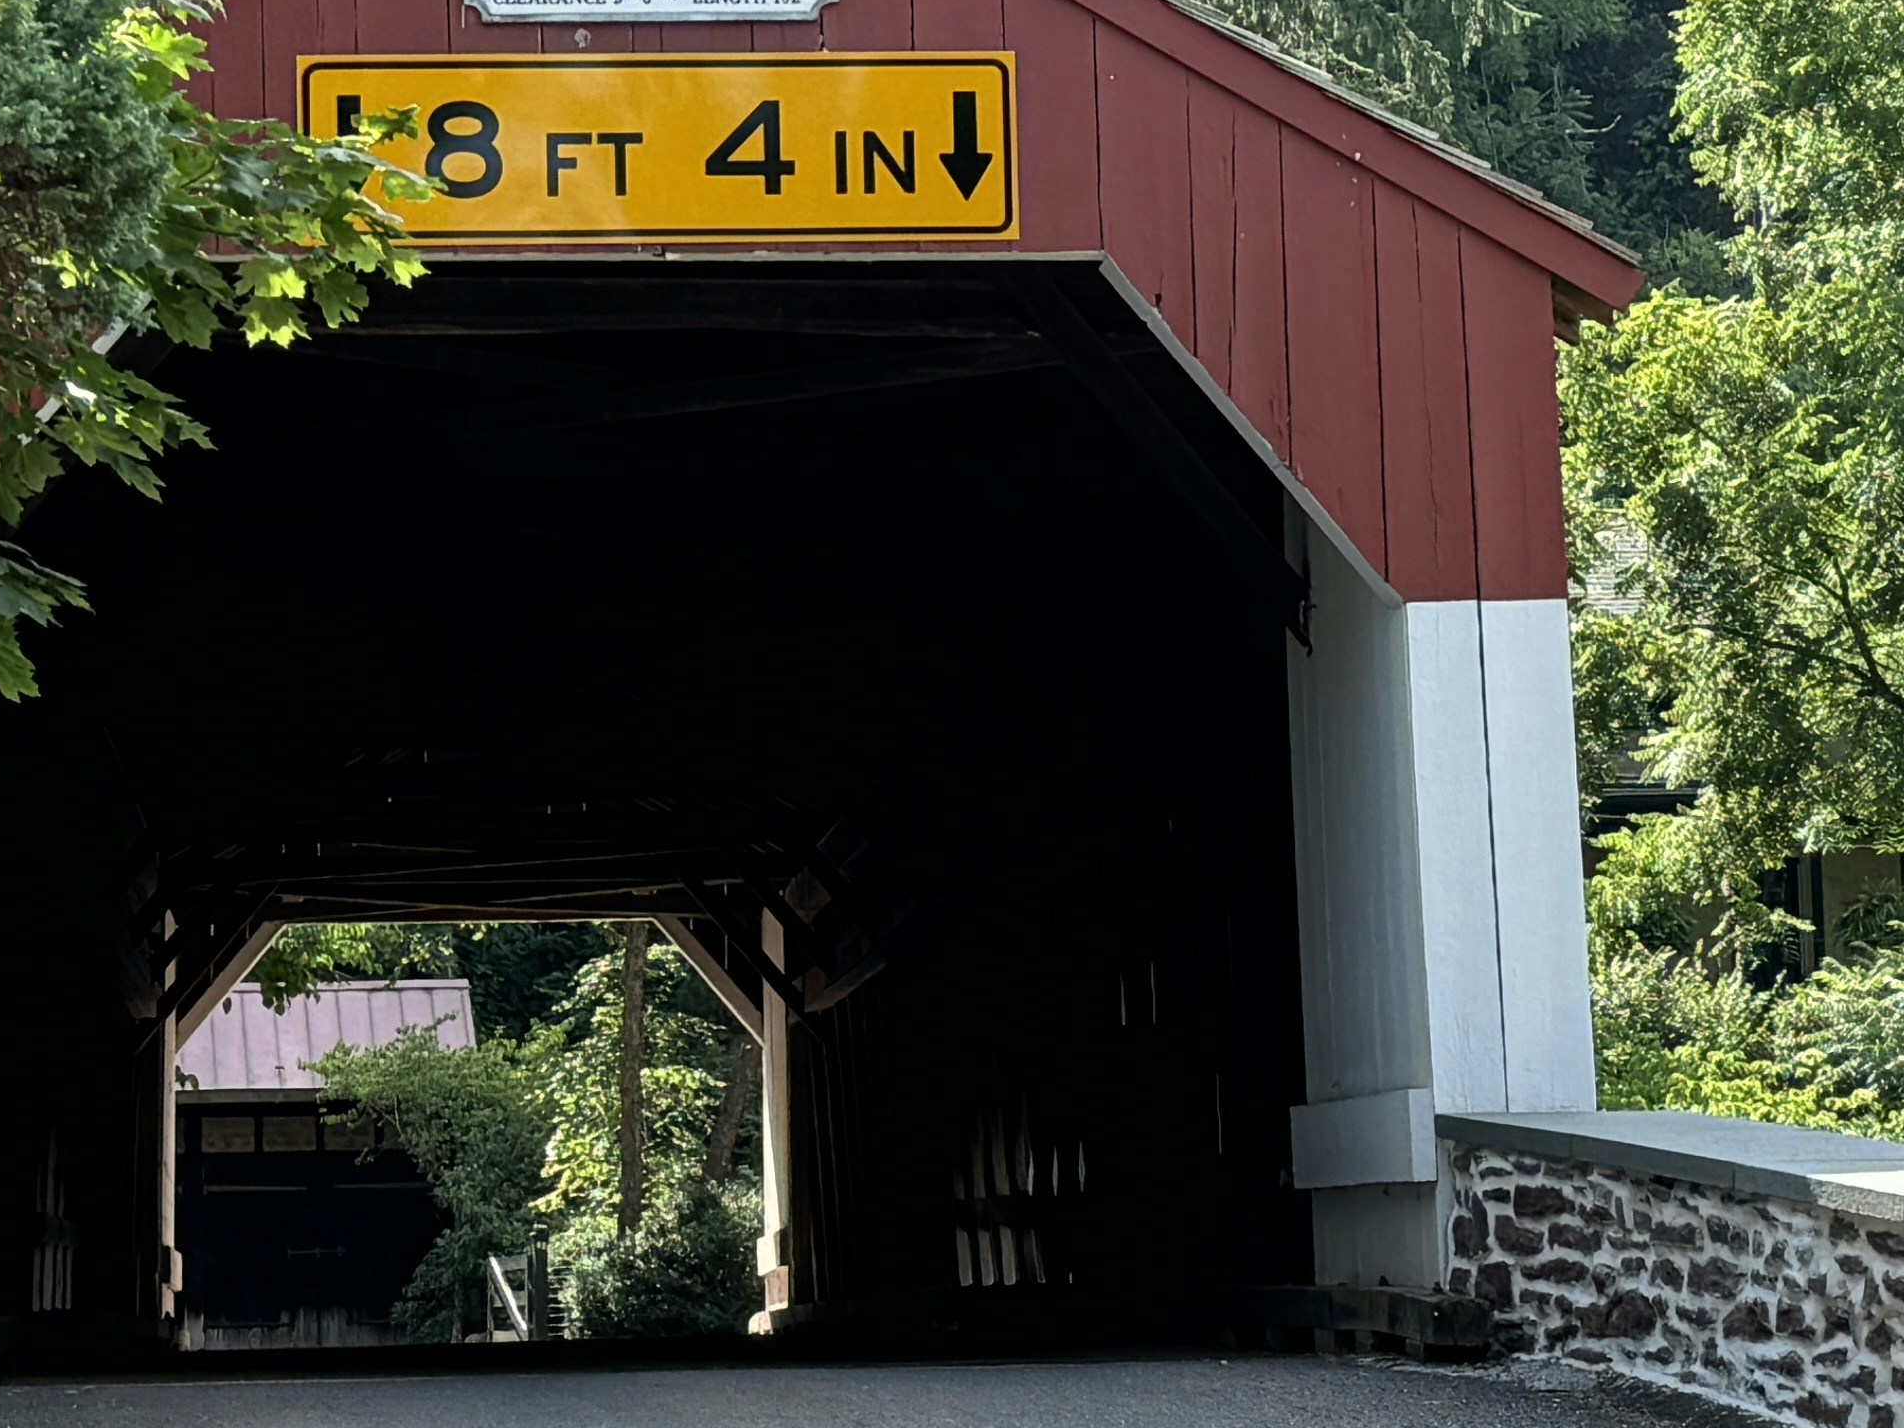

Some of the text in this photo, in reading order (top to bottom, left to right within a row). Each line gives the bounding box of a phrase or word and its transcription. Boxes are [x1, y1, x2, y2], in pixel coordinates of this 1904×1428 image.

[425, 100, 915, 200] 8 FT 4 IN
